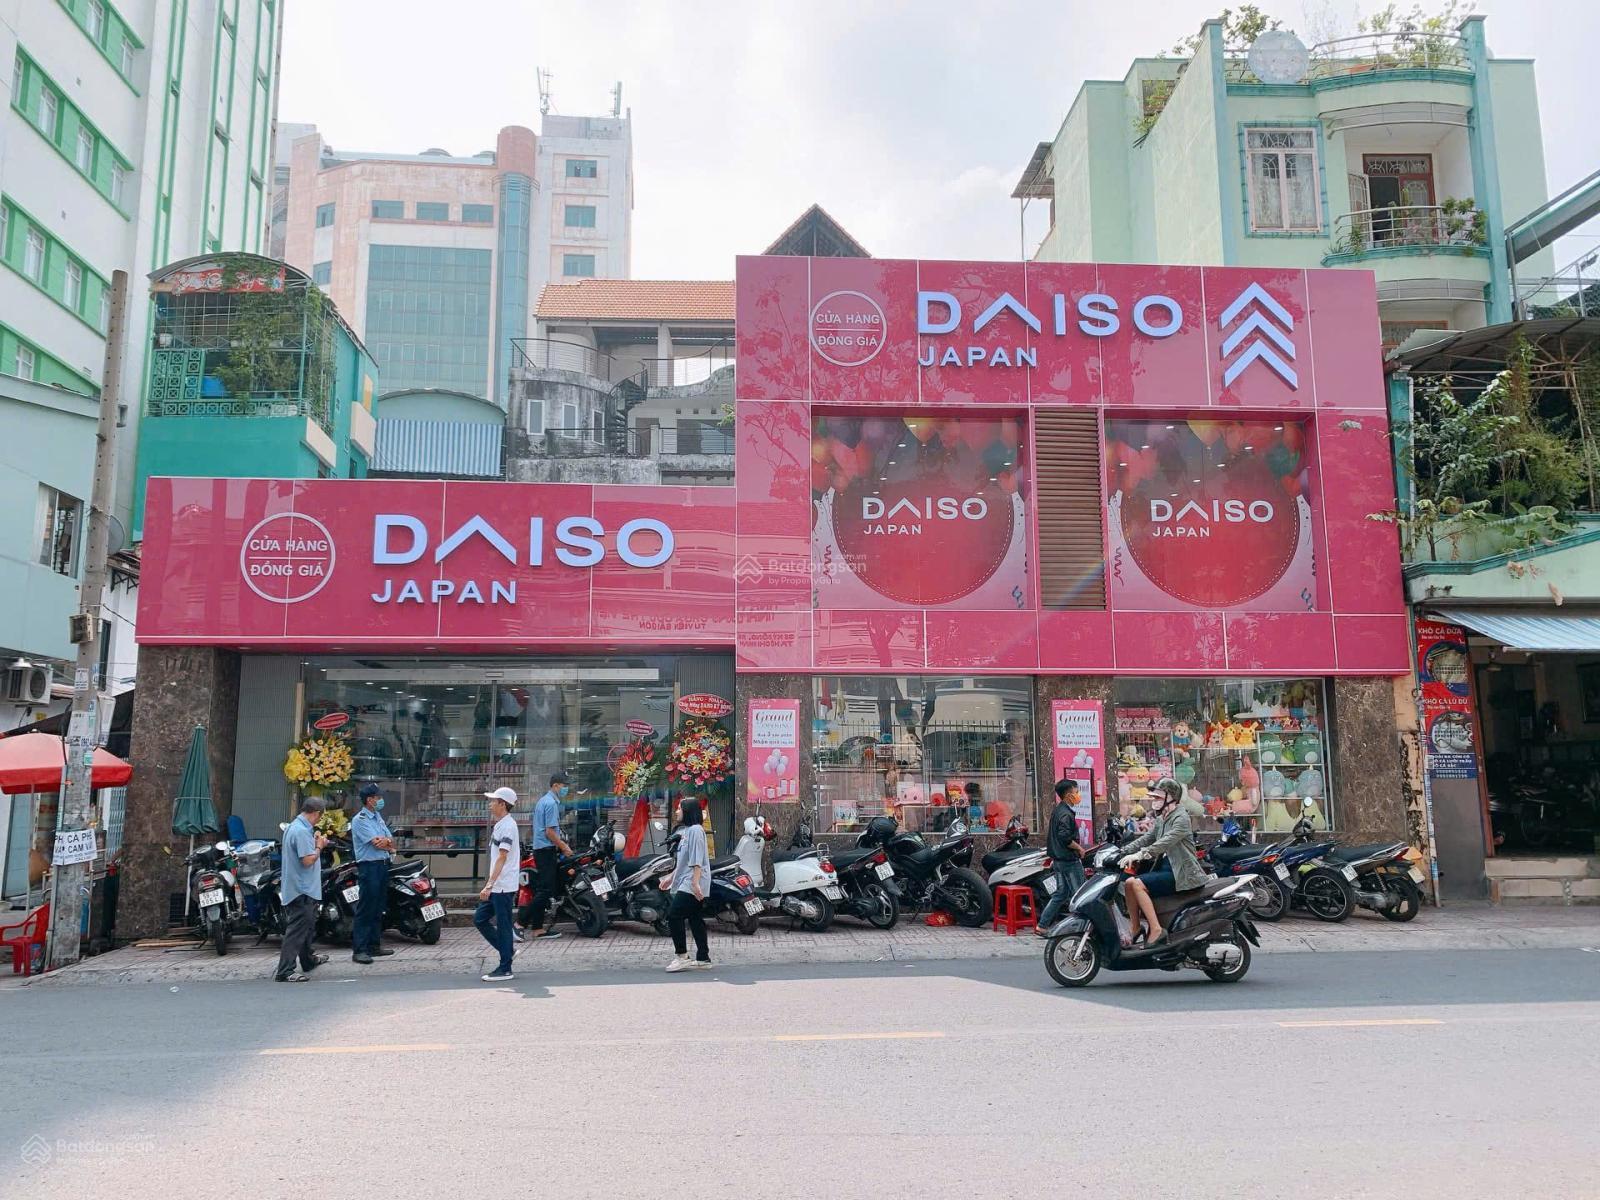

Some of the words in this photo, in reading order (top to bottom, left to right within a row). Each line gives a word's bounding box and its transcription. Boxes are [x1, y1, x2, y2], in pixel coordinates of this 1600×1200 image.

[816, 310, 842, 324] CỬA
[846, 312, 880, 324] HÀNG
[917, 291, 1183, 337] DAISO
[857, 334, 878, 346] GIÁ
[918, 346, 1037, 367] JAPAN
[862, 497, 988, 520] DAISO
[1150, 499, 1274, 523] DAISO
[863, 524, 922, 535] JAPAN
[1152, 527, 1210, 537] JAPAN
[249, 535, 280, 551] CỬA
[285, 536, 328, 551] HÀNG
[372, 514, 675, 568] DAISO
[250, 560, 293, 576] ĐỒNG
[298, 561, 324, 576] GIÁ
[371, 579, 517, 604] JAPAN
[756, 711, 793, 723] Grand
[1059, 712, 1096, 725] Grand
